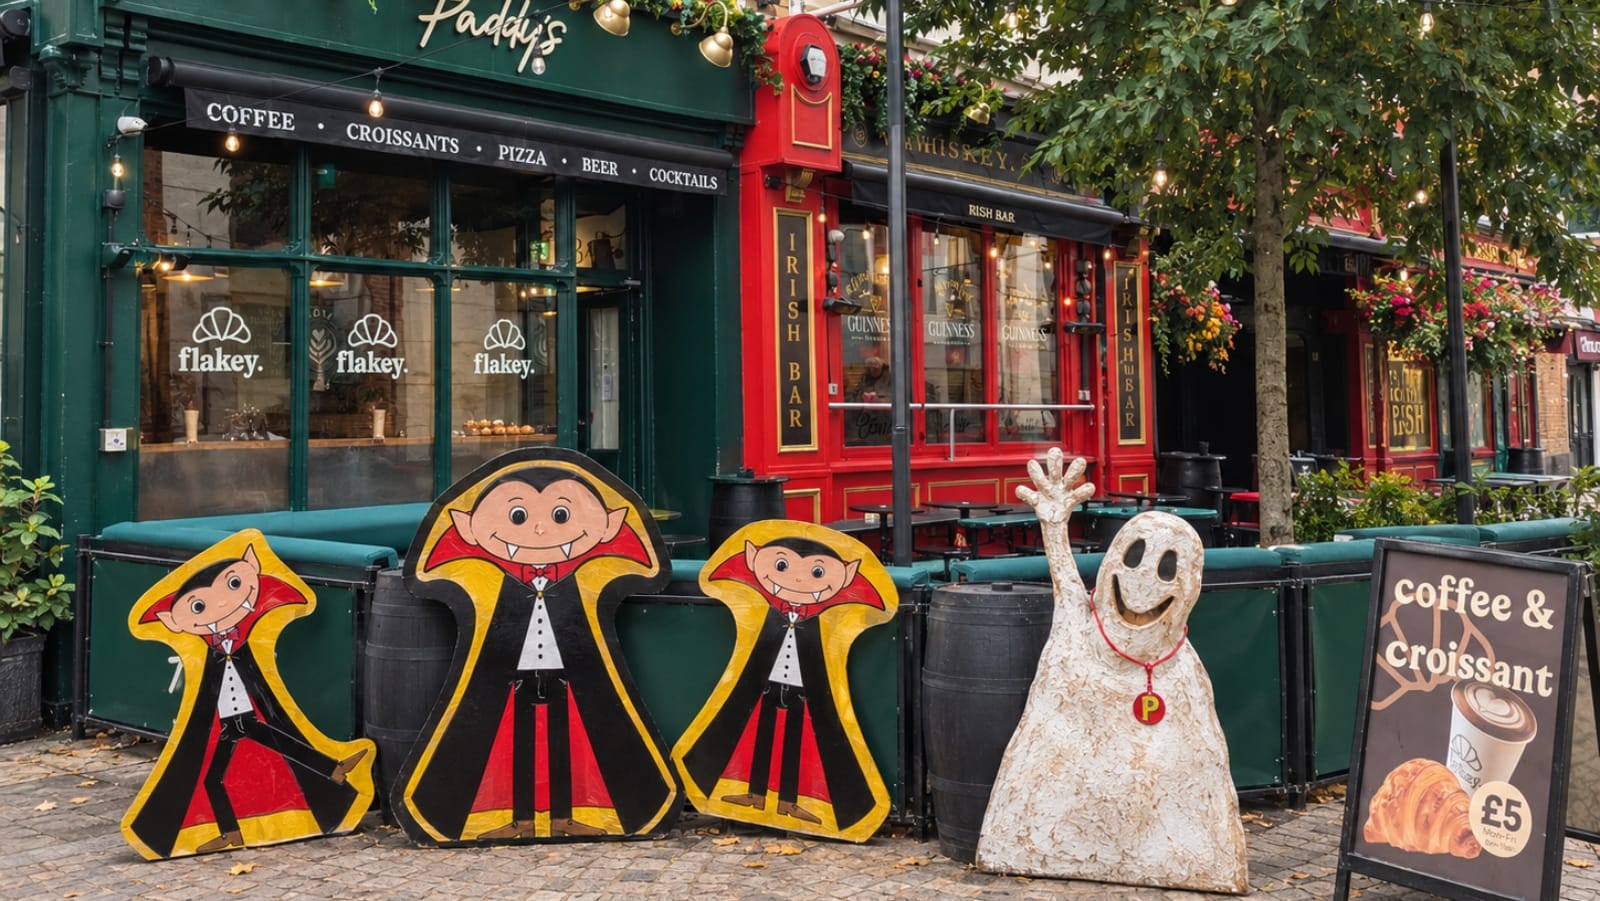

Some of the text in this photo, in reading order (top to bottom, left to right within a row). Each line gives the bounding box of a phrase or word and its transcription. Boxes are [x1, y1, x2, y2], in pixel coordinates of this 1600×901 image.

[418, 0, 567, 73] Paddy's
[206, 102, 718, 190] COFFEE CROISSANTS PIZZA BEER COCKTAILS
[968, 204, 1016, 224] RISH BAR
[786, 233, 803, 428] IRISH BAR
[928, 321, 975, 338] GUINNESS
[1002, 324, 1048, 342] GUINNESS
[178, 347, 263, 378] flakey.
[336, 351, 409, 379] flakey.
[473, 353, 535, 379] flakey.
[1394, 574, 1555, 630] coffee &
[1385, 640, 1554, 697] croissant
[1142, 695, 1160, 721] P
[1481, 794, 1522, 832] £5
